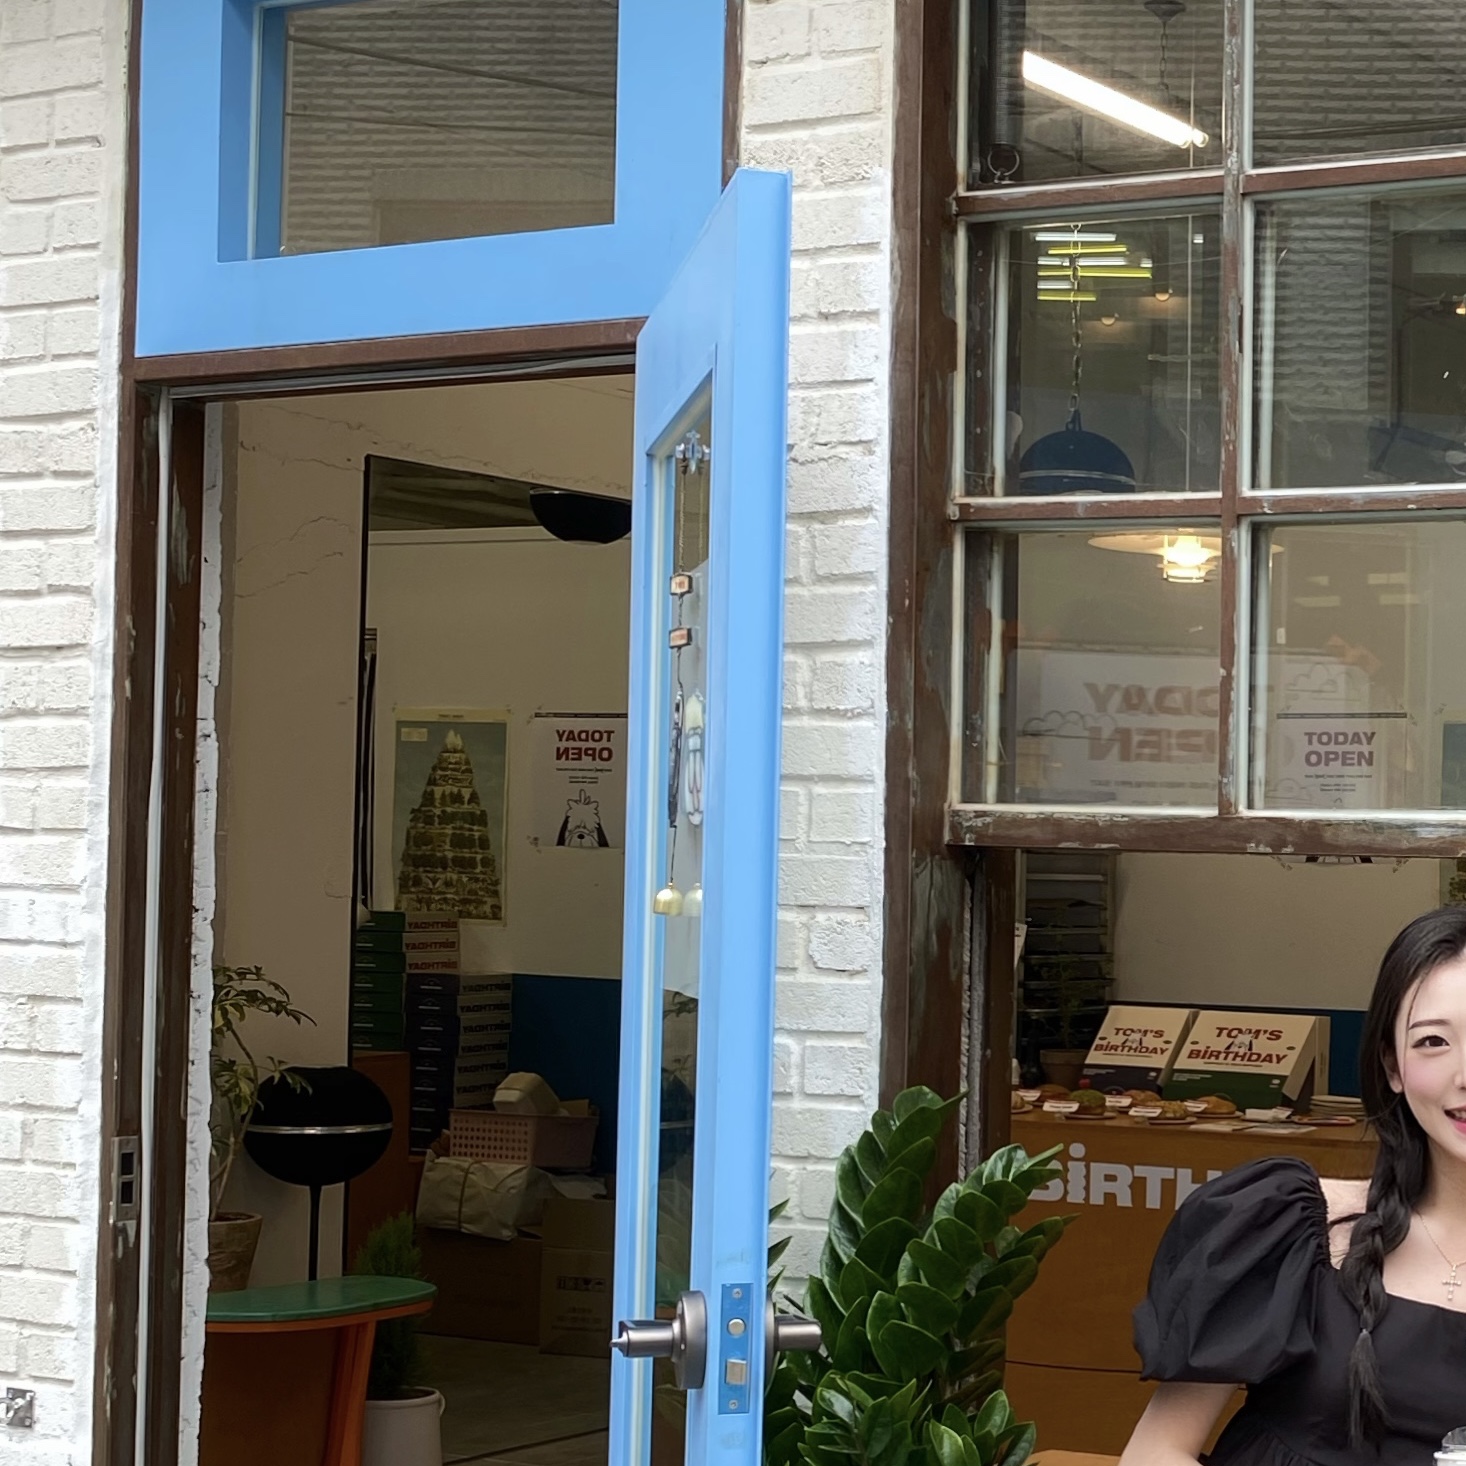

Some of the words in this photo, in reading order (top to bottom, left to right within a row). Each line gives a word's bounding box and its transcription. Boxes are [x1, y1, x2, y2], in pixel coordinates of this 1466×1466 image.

[1303, 731, 1377, 746] TODAY
[1304, 750, 1374, 767] OPEN
[1215, 1026, 1285, 1042] TOM'S
